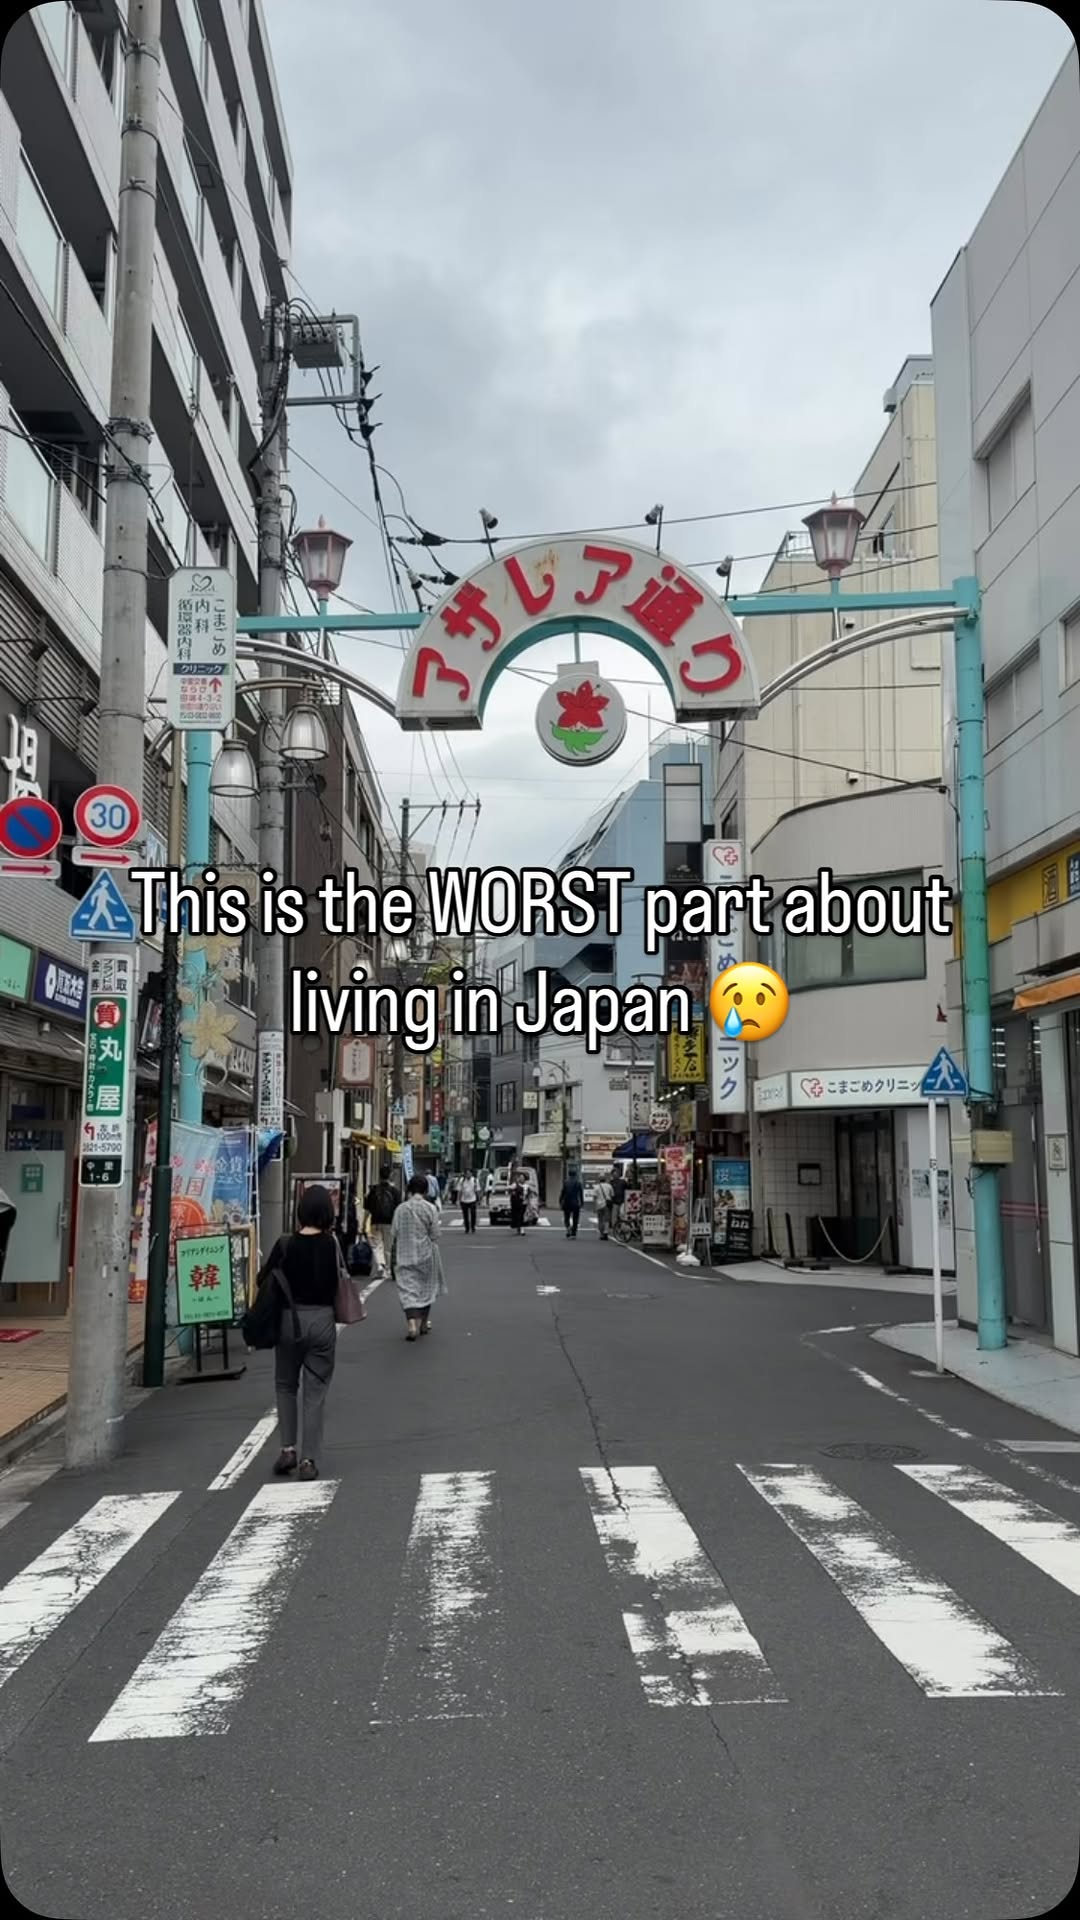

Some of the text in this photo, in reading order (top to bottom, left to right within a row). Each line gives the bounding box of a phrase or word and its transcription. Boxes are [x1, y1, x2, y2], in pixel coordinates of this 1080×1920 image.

[194, 600, 210, 633] 内科
[211, 599, 227, 657] こまごめ
[411, 544, 743, 703] アザレア通り
[180, 664, 222, 674] クリニック
[90, 802, 127, 831] 30
[95, 1036, 122, 1111] 丸屋
[827, 1078, 922, 1094] こまごめクリニッ
[89, 1172, 110, 1183] 1-6
[188, 1264, 221, 1292] 韓
